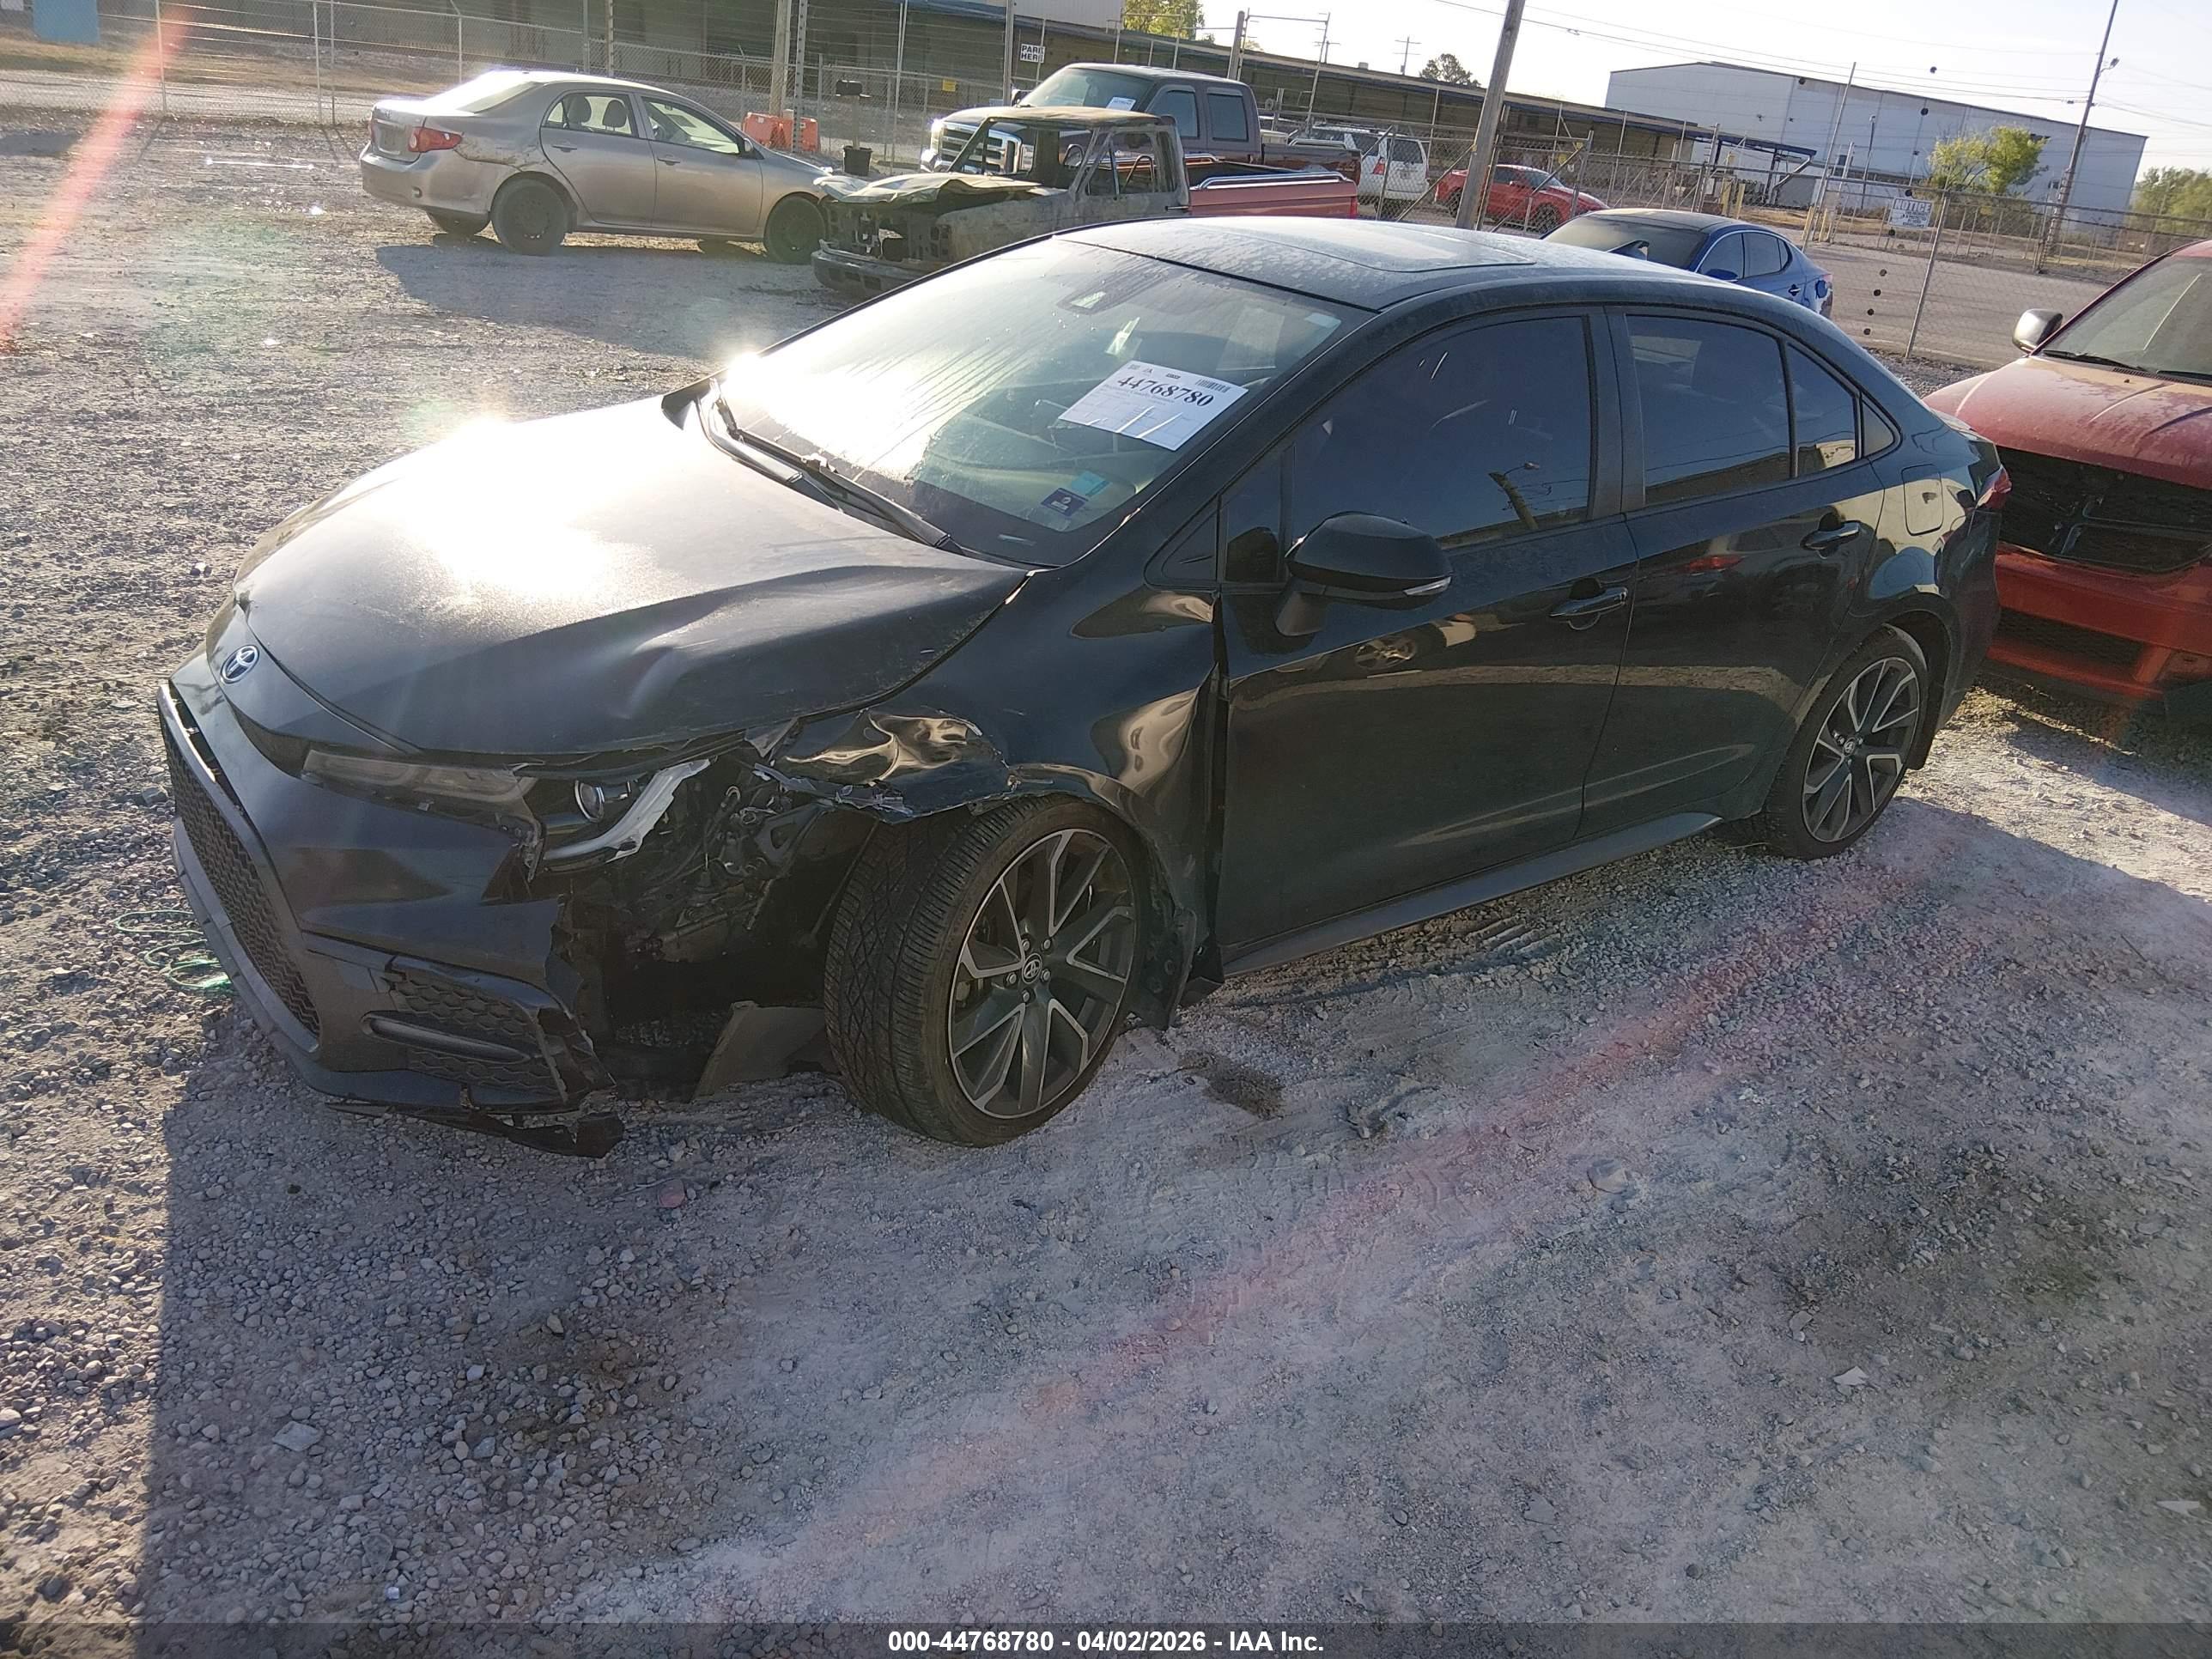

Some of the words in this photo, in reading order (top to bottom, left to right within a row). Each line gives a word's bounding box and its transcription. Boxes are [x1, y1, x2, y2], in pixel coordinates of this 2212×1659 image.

[1022, 46, 1044, 54] PARK
[1894, 199, 1931, 213] NOTICE
[1117, 376, 1214, 407] 44768780
